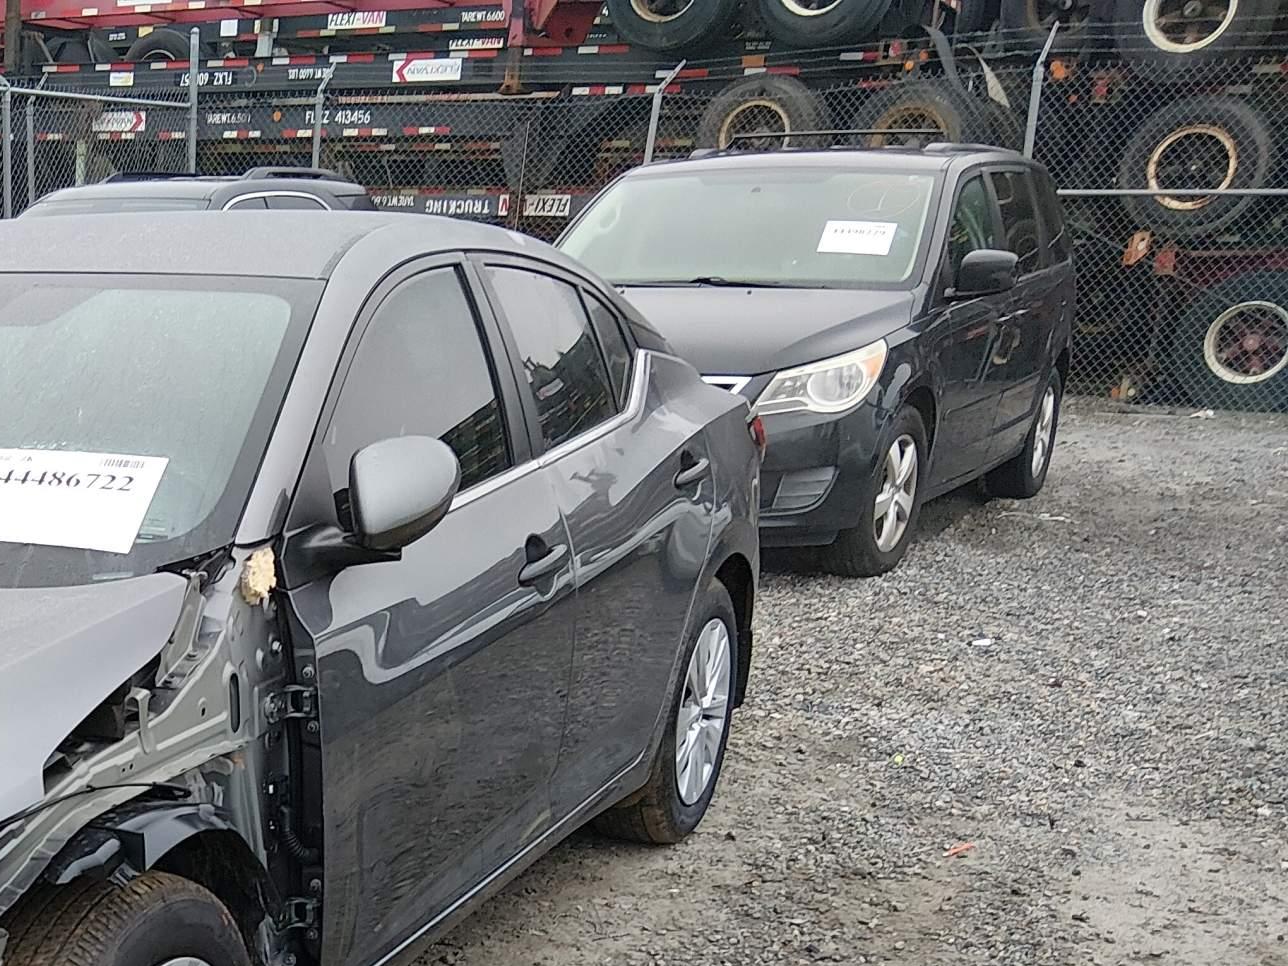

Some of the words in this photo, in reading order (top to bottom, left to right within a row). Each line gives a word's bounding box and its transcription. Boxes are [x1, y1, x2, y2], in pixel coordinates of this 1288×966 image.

[180, 72, 209, 87] 6057
[305, 110, 330, 125] FLZ
[334, 109, 371, 125] 413456
[425, 199, 490, 215] TRUCKING
